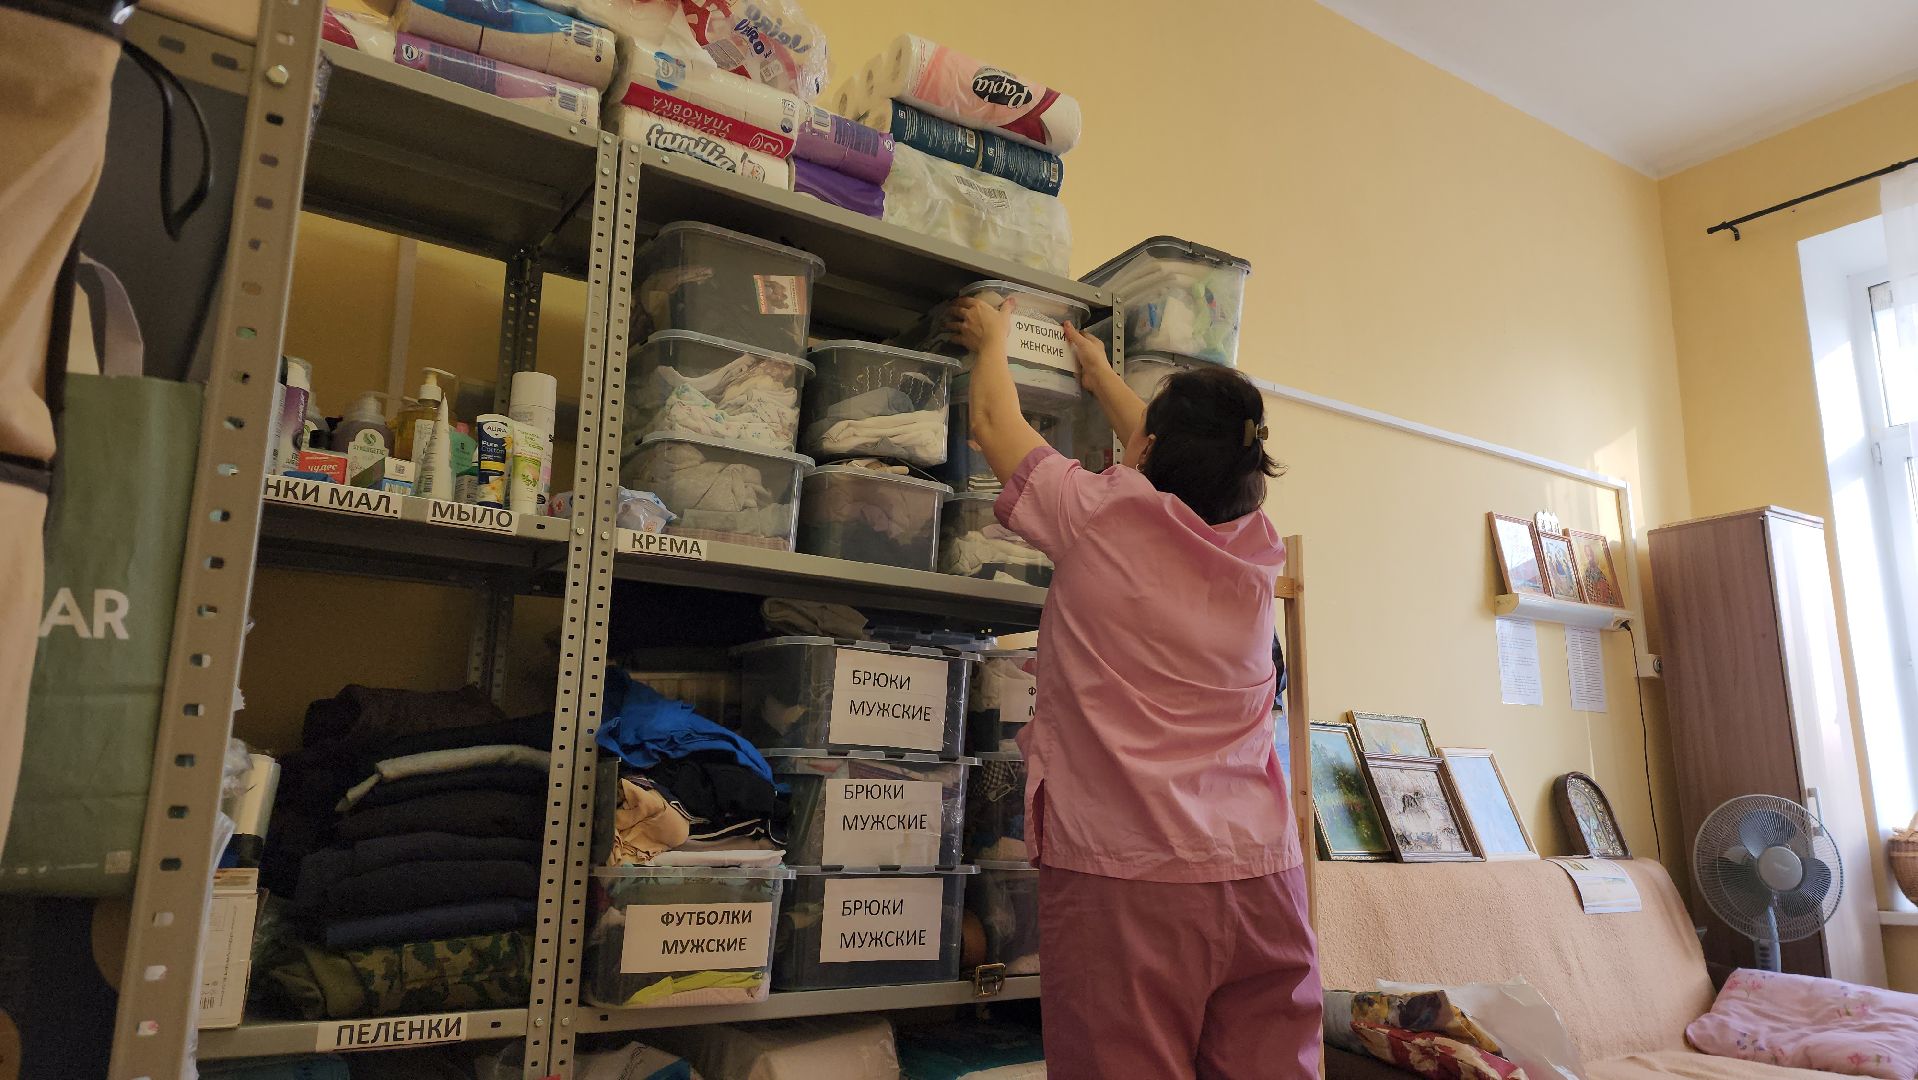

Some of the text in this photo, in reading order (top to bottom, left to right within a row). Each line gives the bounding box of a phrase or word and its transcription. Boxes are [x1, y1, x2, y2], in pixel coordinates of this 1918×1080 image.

[974, 75, 1030, 110] Papia
[651, 96, 733, 134] УПАКОВКА
[646, 123, 736, 173] familia
[1015, 321, 1067, 342] ФУТБОЛКИ
[1020, 339, 1064, 358] ЖЕНСКИЕ
[486, 425, 508, 434] AURA
[263, 477, 320, 503] НКИ
[328, 487, 398, 514] МАЛ.
[431, 501, 513, 528] МЫЛО
[631, 533, 702, 556] КРЕМА
[38, 586, 130, 640] AR
[852, 669, 911, 690] БРЮКИ
[849, 699, 932, 722] МУЖСКИЕ
[844, 784, 904, 800] БРЮКИ
[842, 814, 928, 831] МУЖСКИЕ
[660, 909, 753, 927] ФУТБОЛКИ
[841, 899, 904, 916] БРЮКИ
[661, 937, 748, 955] МУЖСКИЕ
[840, 929, 927, 949] МУЖСКИЕ
[336, 1016, 462, 1046] ПЕЛЕНКИ
